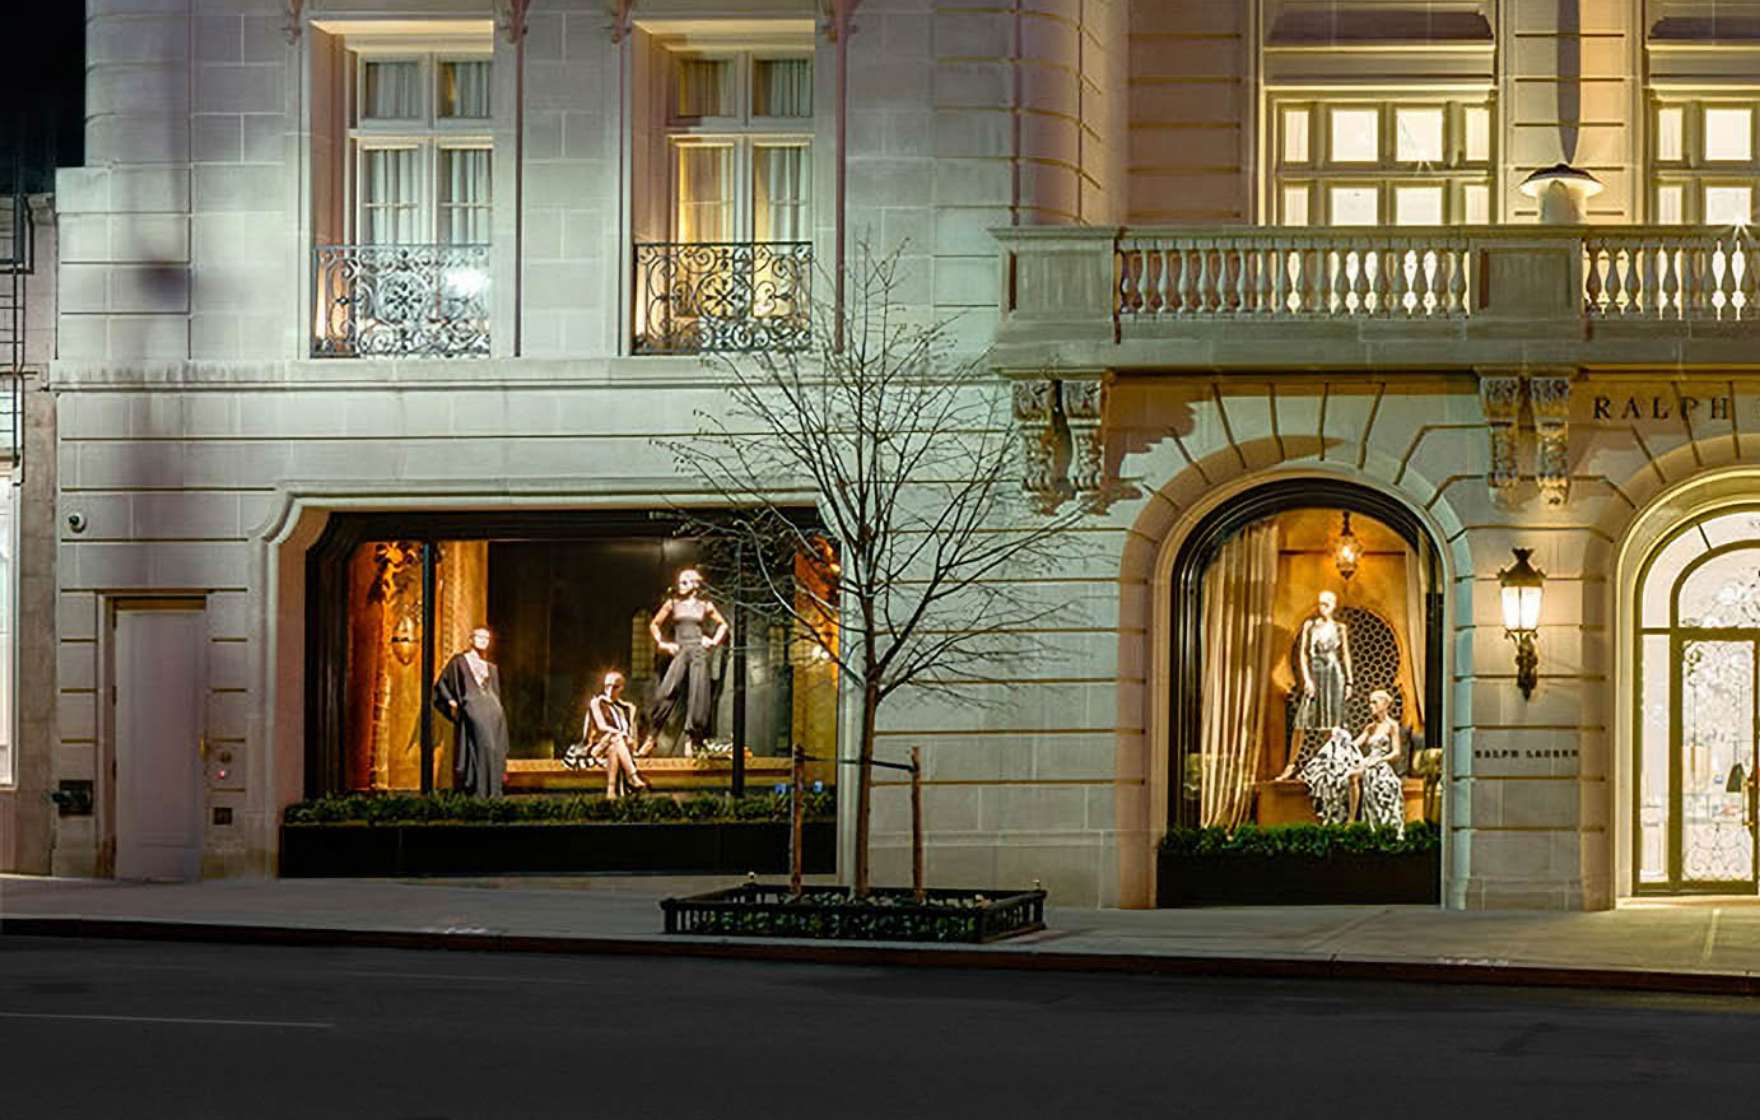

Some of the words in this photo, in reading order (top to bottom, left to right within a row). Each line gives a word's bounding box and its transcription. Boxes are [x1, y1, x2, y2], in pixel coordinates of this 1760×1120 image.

[1593, 396, 1729, 420] RALPH
[1474, 749, 1520, 759] RALPH
[1526, 749, 1580, 759] LAUREN
